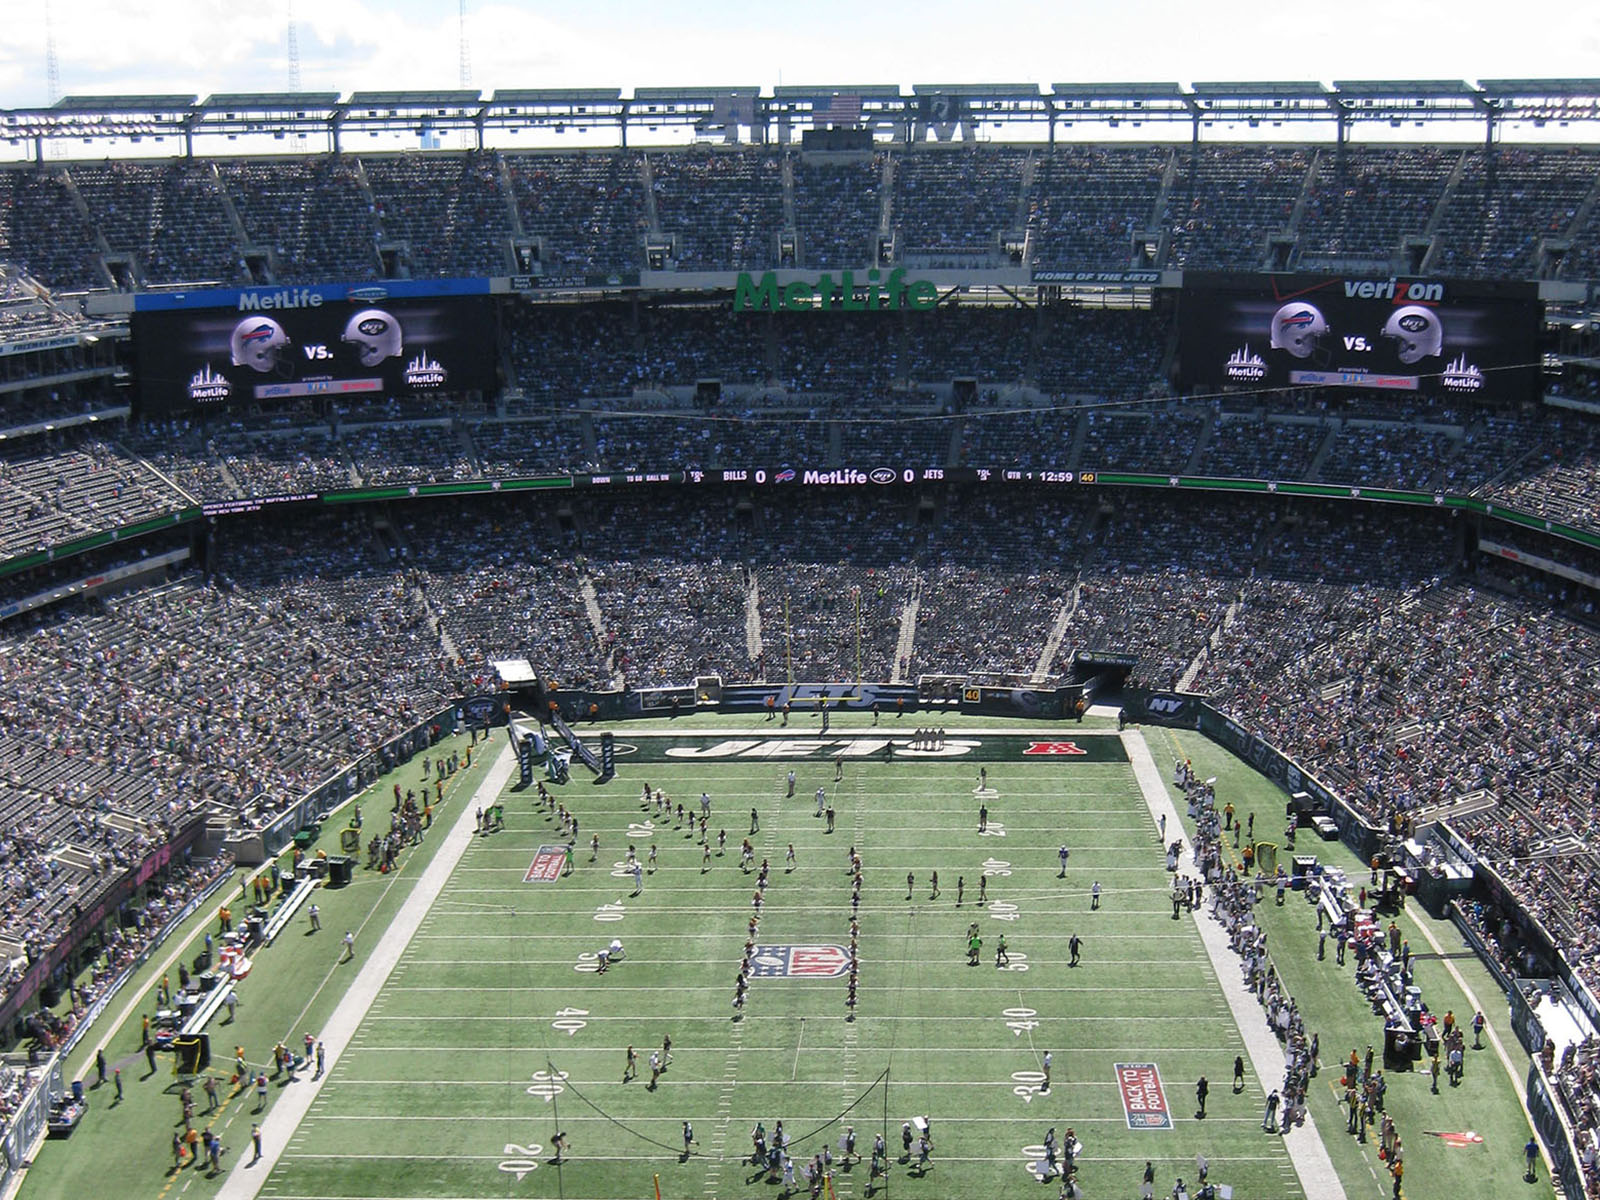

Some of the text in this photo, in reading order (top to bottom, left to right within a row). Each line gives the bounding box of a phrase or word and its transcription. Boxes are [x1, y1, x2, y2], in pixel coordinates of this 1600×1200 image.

[1034, 272, 1075, 280] HOME
[1096, 273, 1123, 281] THE
[1123, 273, 1159, 281] JETS
[733, 268, 938, 312] MetLife
[1343, 276, 1443, 306] verizon
[239, 289, 323, 311] MetLife
[1343, 336, 1372, 351] vs.
[305, 345, 334, 360] vs.
[408, 375, 444, 384] MetLife
[1228, 367, 1264, 377] MetLife
[1443, 378, 1480, 387] MetLife
[192, 387, 229, 399] MetLife
[723, 470, 766, 484] BILLS 0
[803, 469, 867, 485] MetLife
[903, 469, 944, 483] 0 JETS
[1039, 471, 1073, 482] 12:59
[1081, 473, 1094, 482] 40
[763, 685, 883, 708] JETS
[965, 691, 980, 701] 40
[1148, 698, 1183, 713] NY
[664, 738, 984, 760] JETS
[626, 823, 656, 837] 20
[982, 860, 1012, 876] 30
[593, 903, 625, 921] 40
[988, 904, 1020, 921] 40
[792, 947, 845, 974] NFL
[995, 952, 1029, 972] 50
[551, 1007, 590, 1030] 40
[1002, 1007, 1039, 1031] 40
[526, 1070, 569, 1096] 30
[1011, 1071, 1052, 1096] 30
[1122, 1070, 1140, 1083] TO
[1130, 1085, 1147, 1110] BACK
[1140, 1070, 1163, 1110] FOOTBALL
[498, 1143, 544, 1172] 20
